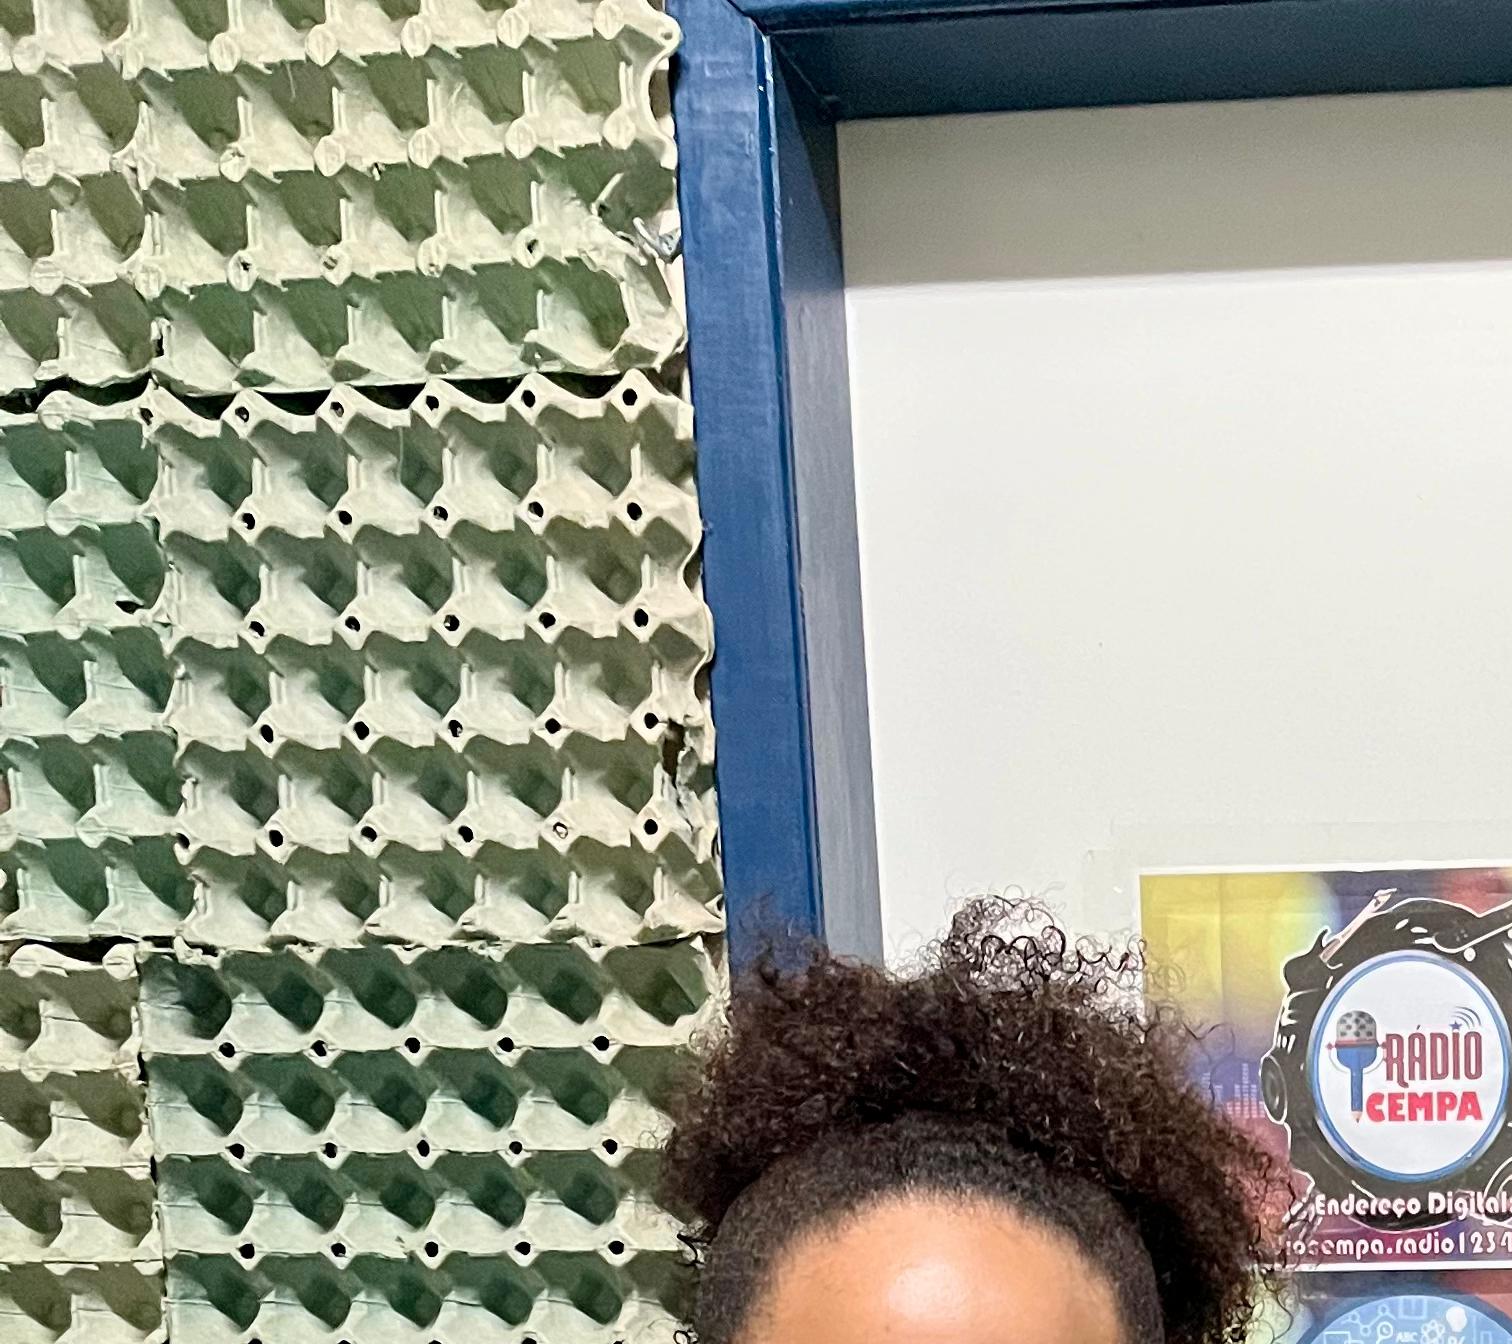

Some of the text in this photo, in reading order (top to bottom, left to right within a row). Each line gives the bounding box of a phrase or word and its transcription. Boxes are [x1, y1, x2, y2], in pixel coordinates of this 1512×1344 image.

[1385, 1024, 1482, 1088] RÁDIO
[1366, 1091, 1482, 1122] CEMPA
[1315, 1194, 1421, 1218] Endereço
